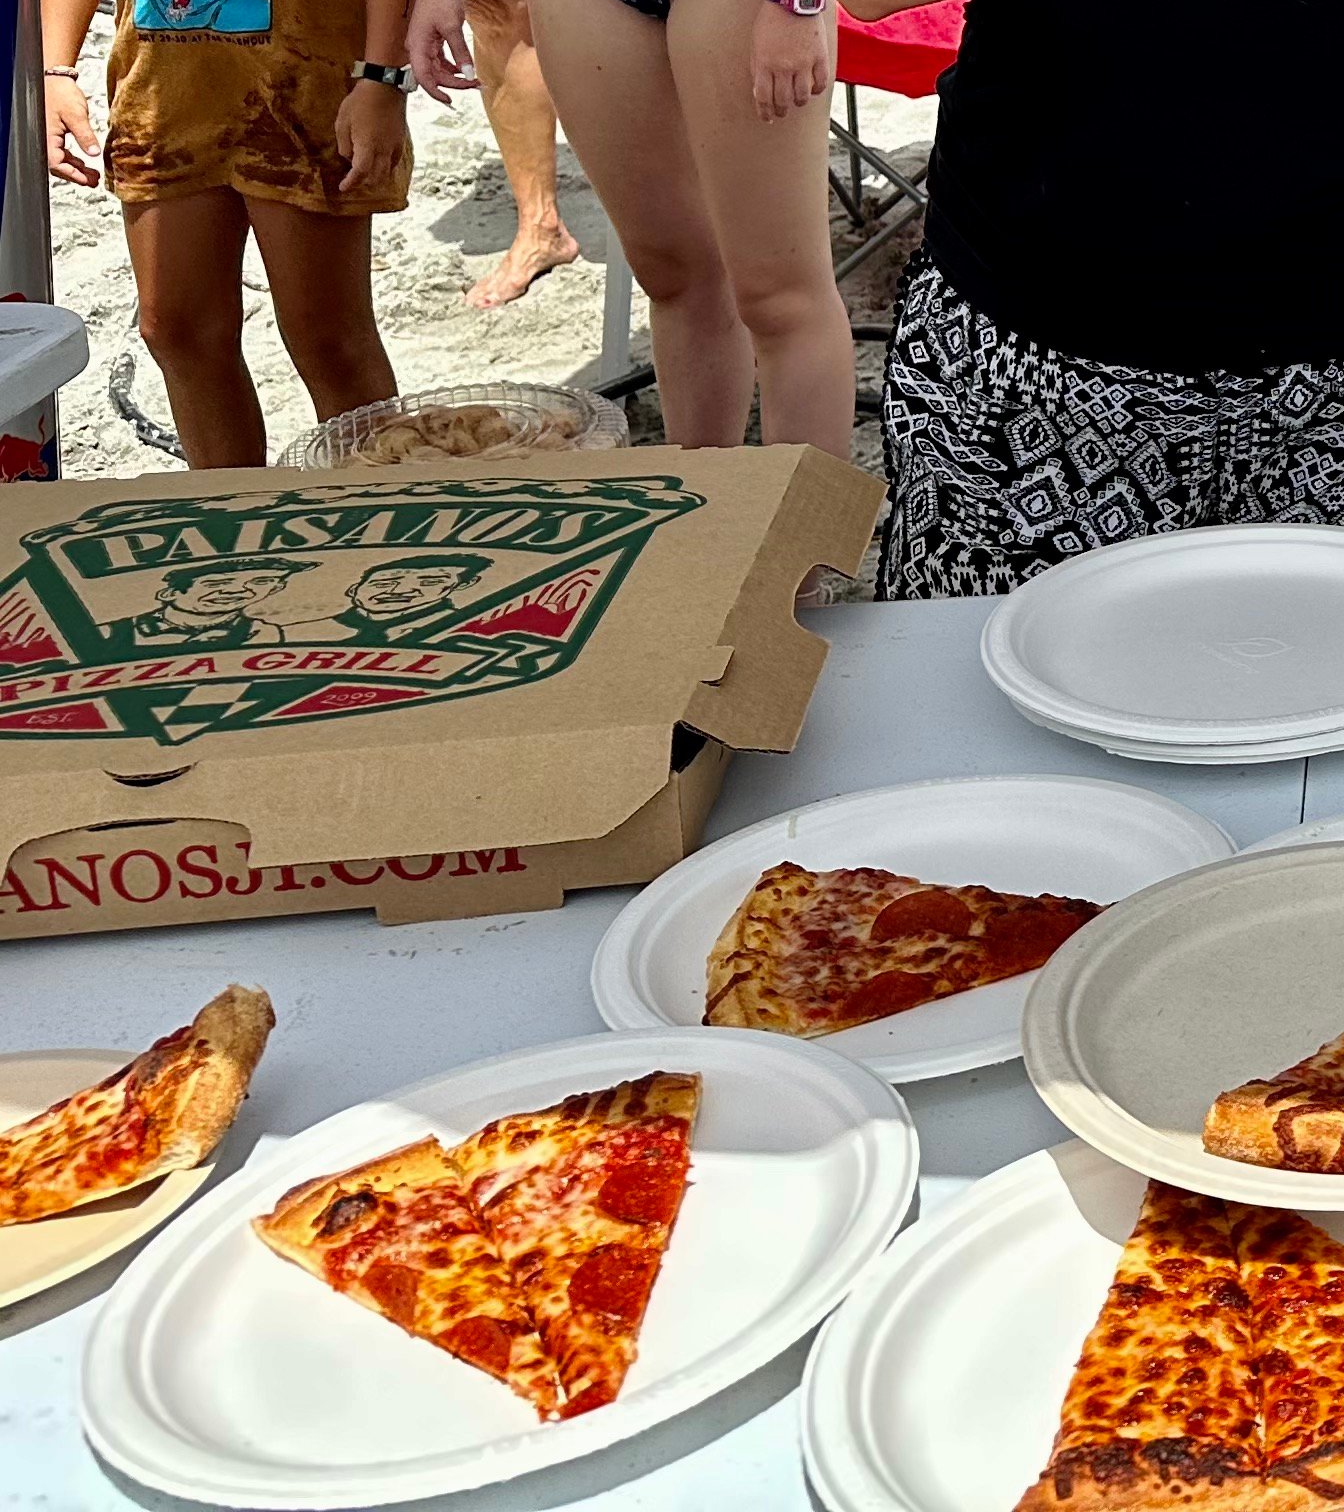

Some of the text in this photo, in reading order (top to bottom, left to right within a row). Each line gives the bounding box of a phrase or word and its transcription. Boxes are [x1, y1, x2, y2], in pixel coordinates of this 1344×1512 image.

[101, 506, 621, 569] PAISANO'S
[0, 651, 442, 702] PIZZA GRILL
[320, 691, 378, 706] 2009
